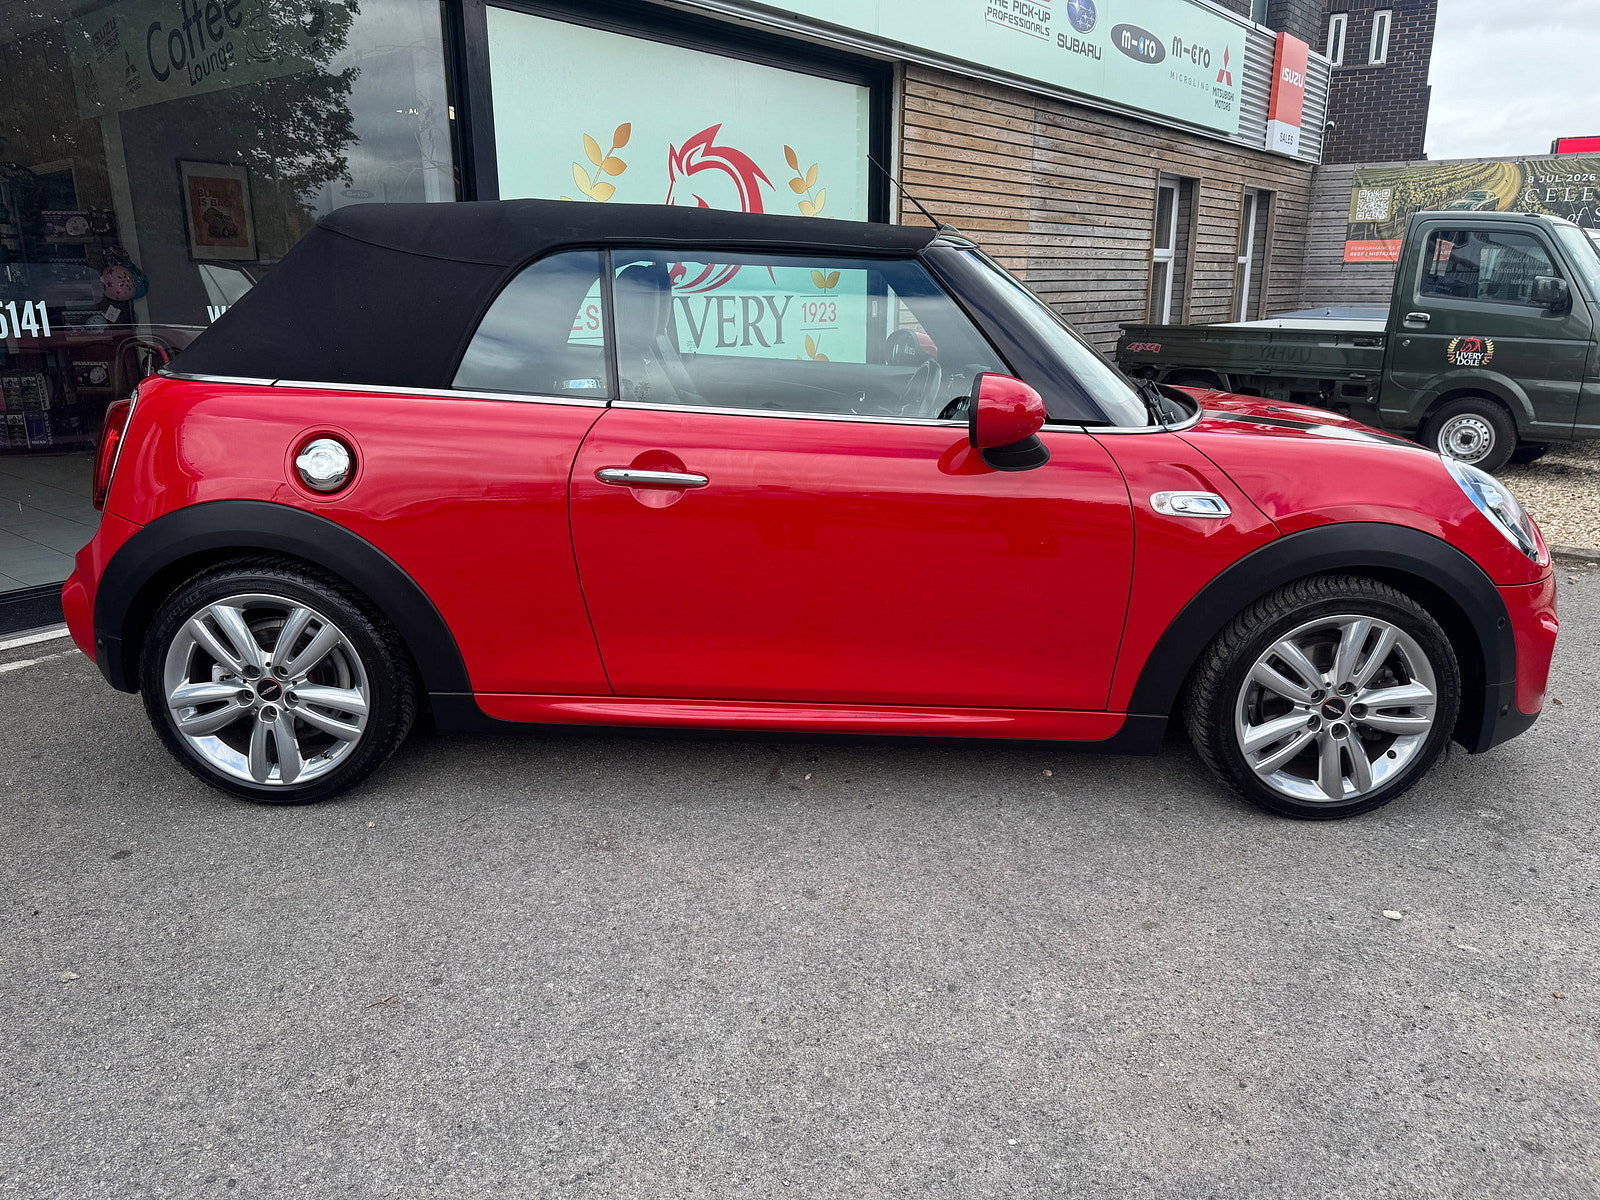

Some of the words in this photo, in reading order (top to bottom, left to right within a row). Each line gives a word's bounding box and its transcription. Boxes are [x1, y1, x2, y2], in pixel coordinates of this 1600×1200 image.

[1012, 0, 1051, 23] PICK-UP
[987, 6, 1050, 37] PROFESSIONALS
[147, 0, 243, 82] Coffee
[1057, 33, 1102, 60] SUBARU
[187, 41, 234, 87] Lounge
[1281, 66, 1304, 88] ISUZU
[1212, 86, 1235, 102] MITSUBISHI
[1214, 99, 1232, 112] MOTORS
[1280, 132, 1294, 145] SALES
[1527, 175, 1535, 184] 8
[1539, 174, 1562, 183] JUL
[1566, 173, 1597, 182] 2026
[1524, 186, 1595, 203] CELE
[801, 302, 837, 324] 1923
[1455, 351, 1484, 360] LIVERY
[1456, 358, 1480, 366] DOLE
